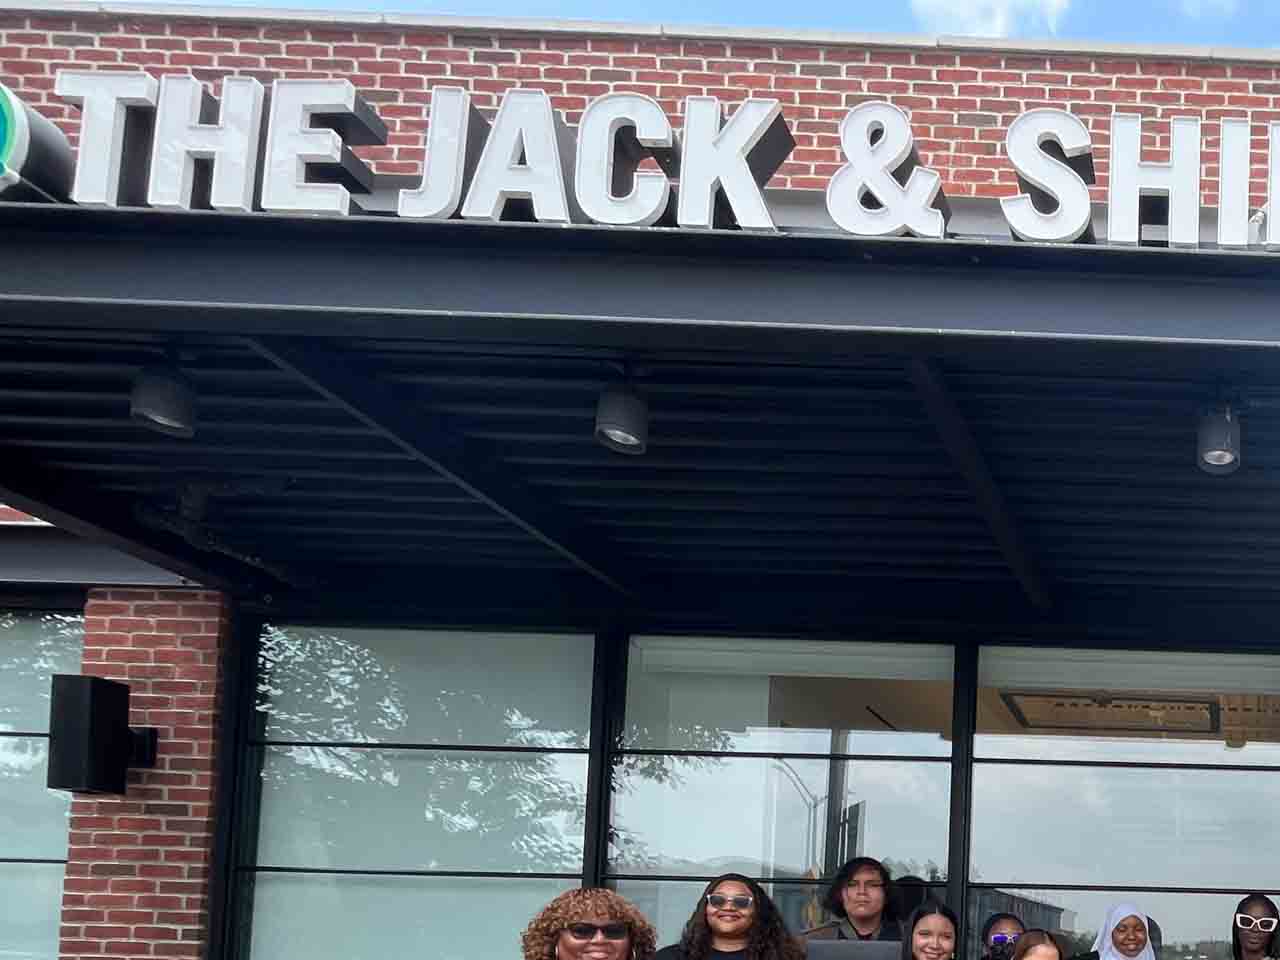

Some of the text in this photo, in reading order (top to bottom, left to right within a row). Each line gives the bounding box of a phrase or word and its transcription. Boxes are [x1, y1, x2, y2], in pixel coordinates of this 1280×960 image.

[55, 69, 357, 216] THE
[398, 86, 782, 232] JACK
[826, 100, 946, 238] &
